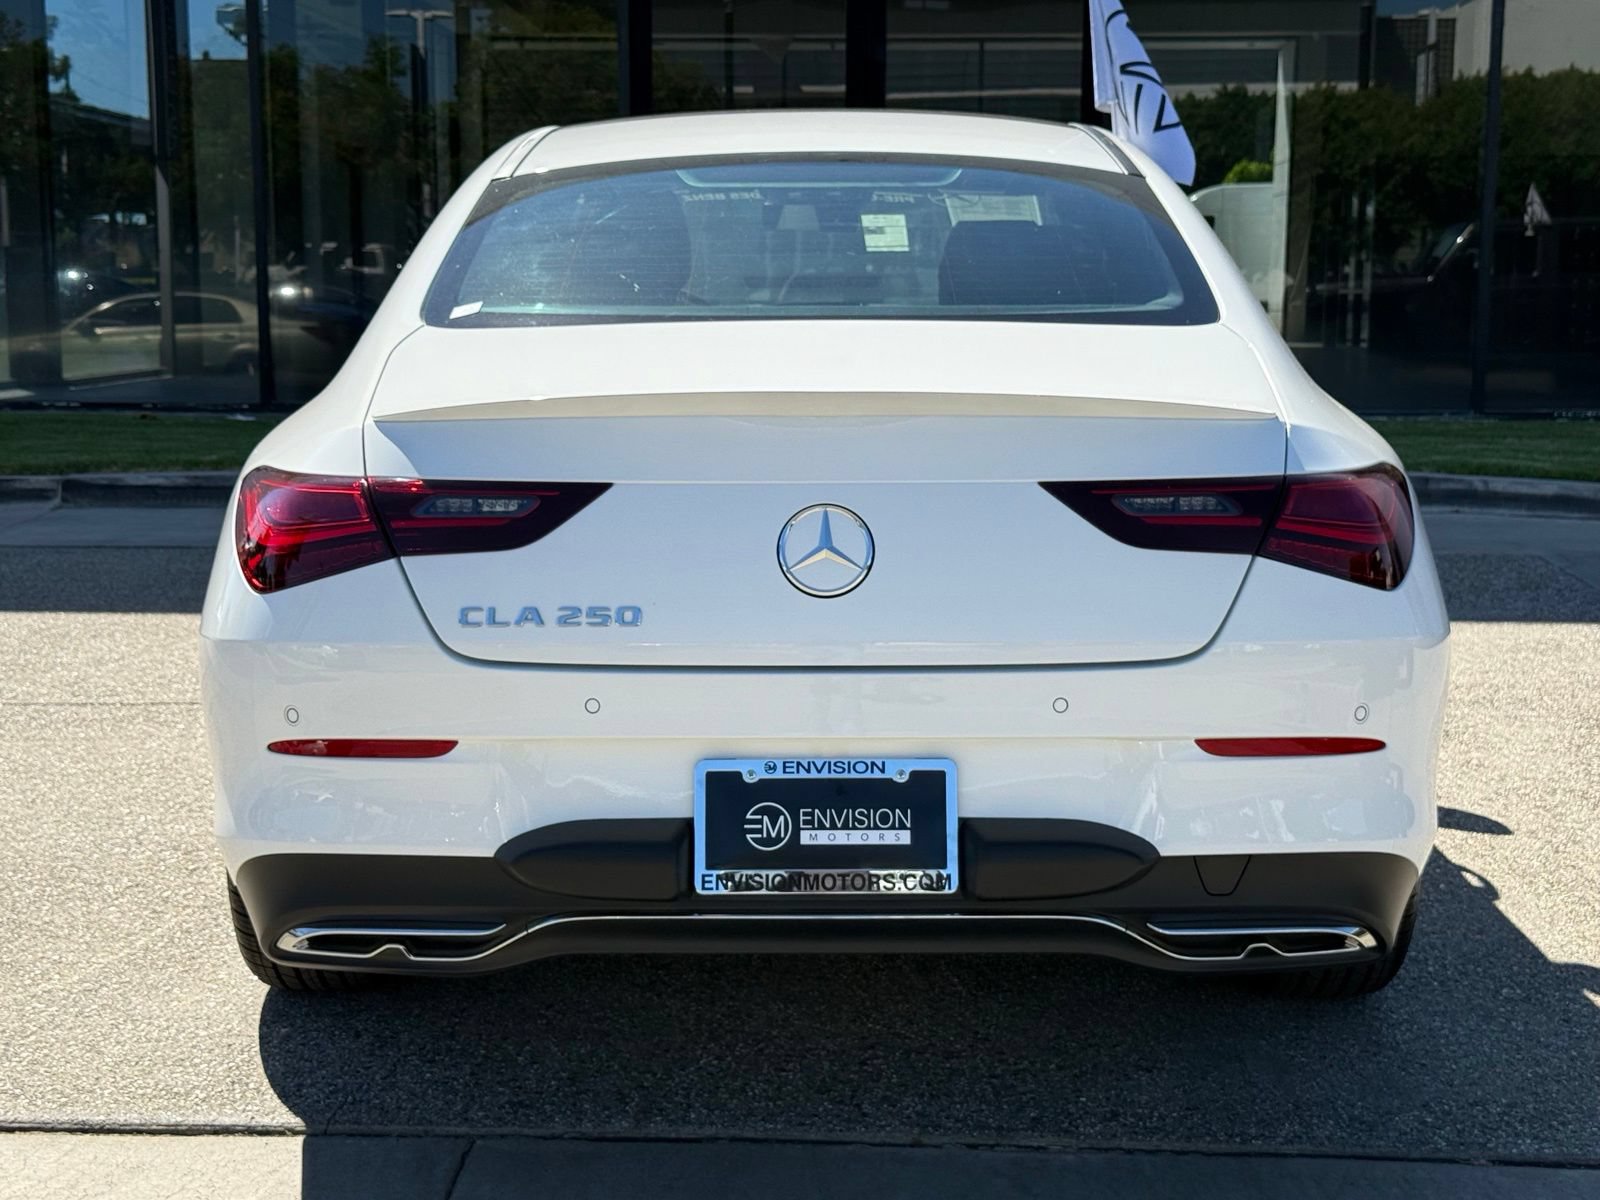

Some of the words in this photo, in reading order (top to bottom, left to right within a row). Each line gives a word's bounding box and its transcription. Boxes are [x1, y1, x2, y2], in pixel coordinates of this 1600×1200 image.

[458, 606, 546, 628] CLA
[556, 605, 643, 627] 250
[782, 760, 886, 775] ENVISION
[799, 808, 912, 829] ENVISION
[808, 832, 902, 842] MOTORS
[700, 872, 952, 892] ENVISIONMOTORS.COM
